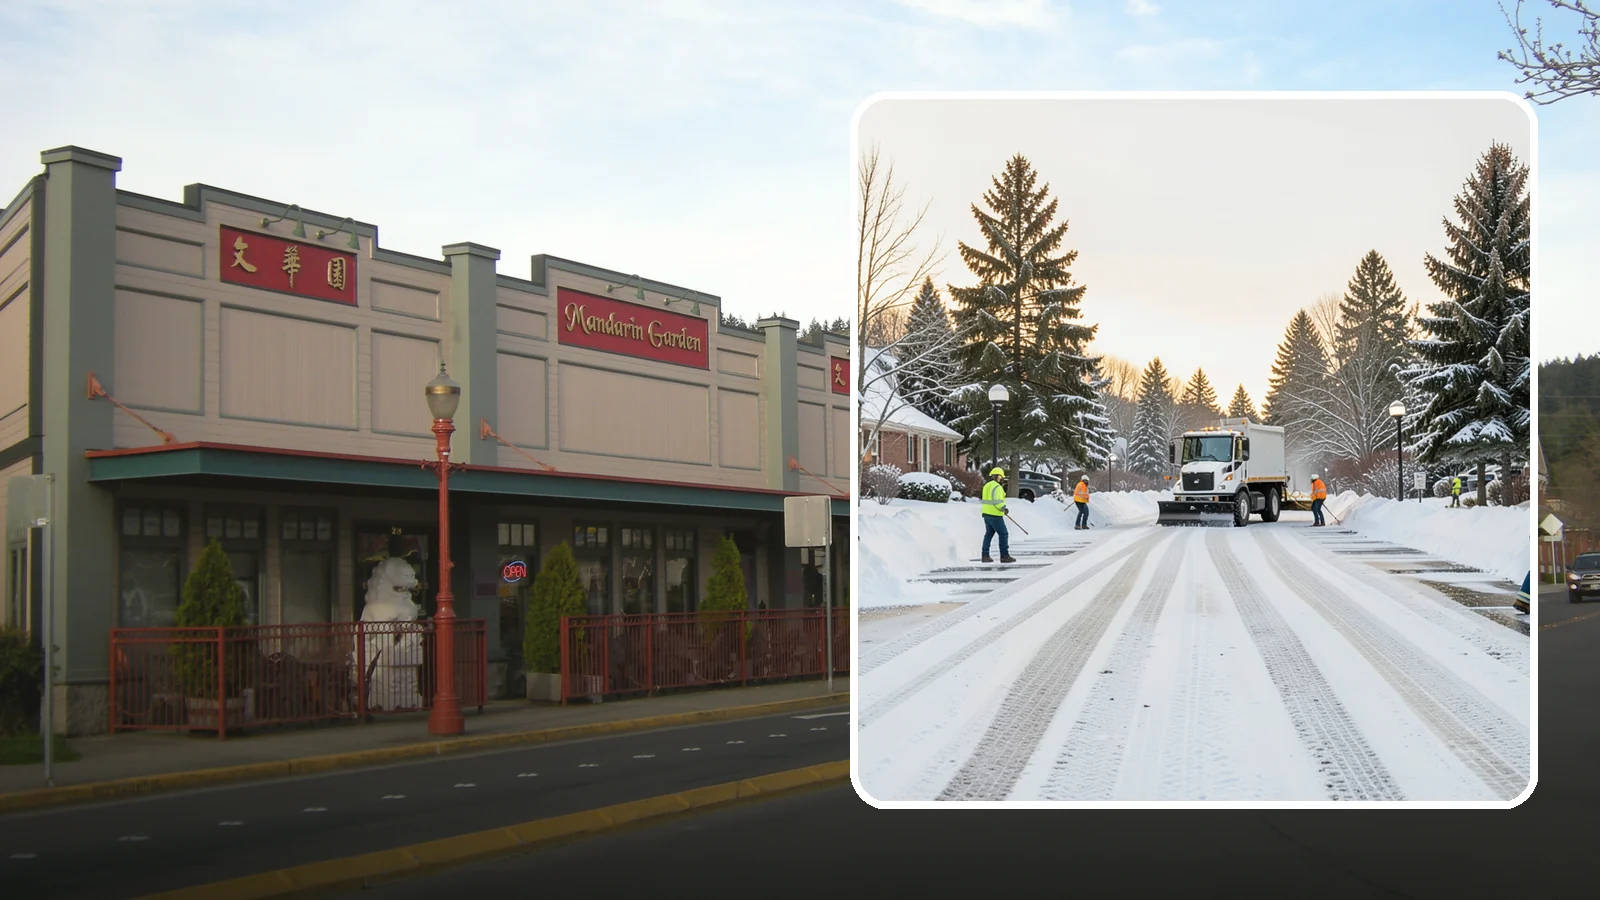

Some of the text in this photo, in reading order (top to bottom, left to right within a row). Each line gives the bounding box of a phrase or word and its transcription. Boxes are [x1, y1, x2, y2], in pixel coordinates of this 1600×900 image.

[231, 236, 346, 291] 文華園
[564, 302, 701, 352] Mandarin Garden
[503, 565, 527, 578] OPEN
